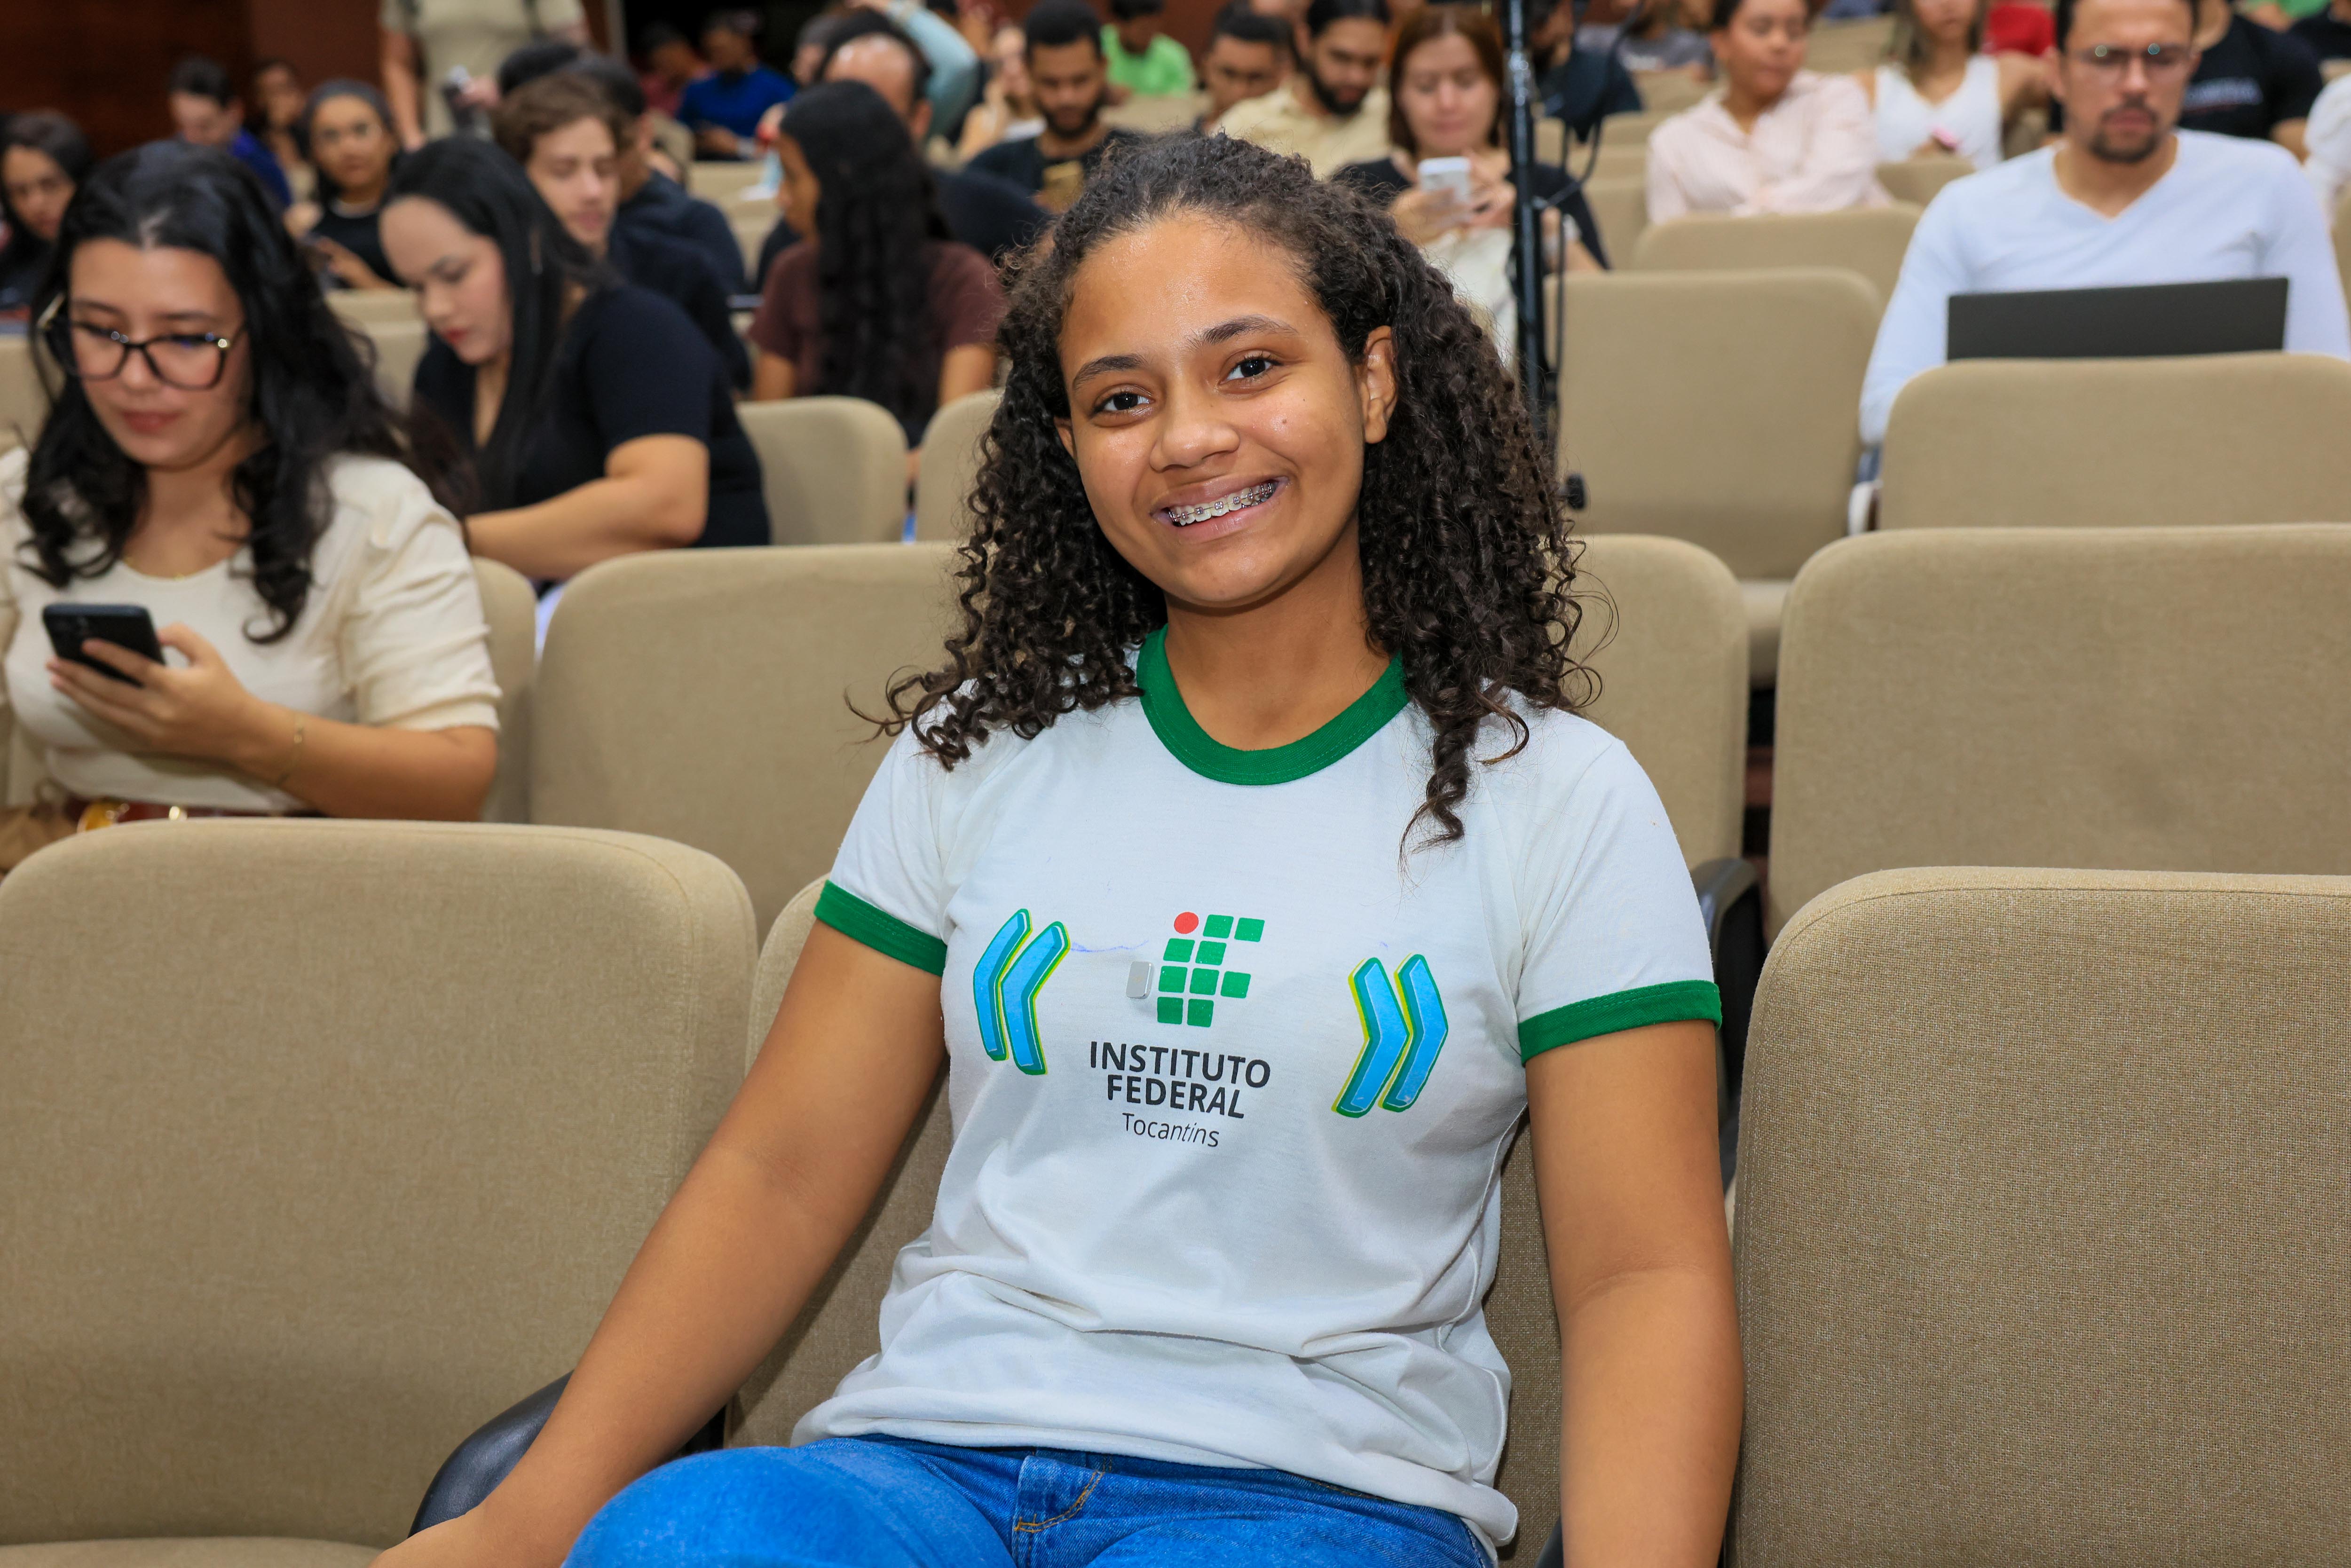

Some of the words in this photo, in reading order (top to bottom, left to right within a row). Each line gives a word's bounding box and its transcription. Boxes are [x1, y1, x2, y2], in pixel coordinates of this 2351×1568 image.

[1090, 1041, 1270, 1088] INSTITUTO
[1107, 1074, 1245, 1119] FEDERAL
[1122, 1112, 1220, 1147] Tocantins
